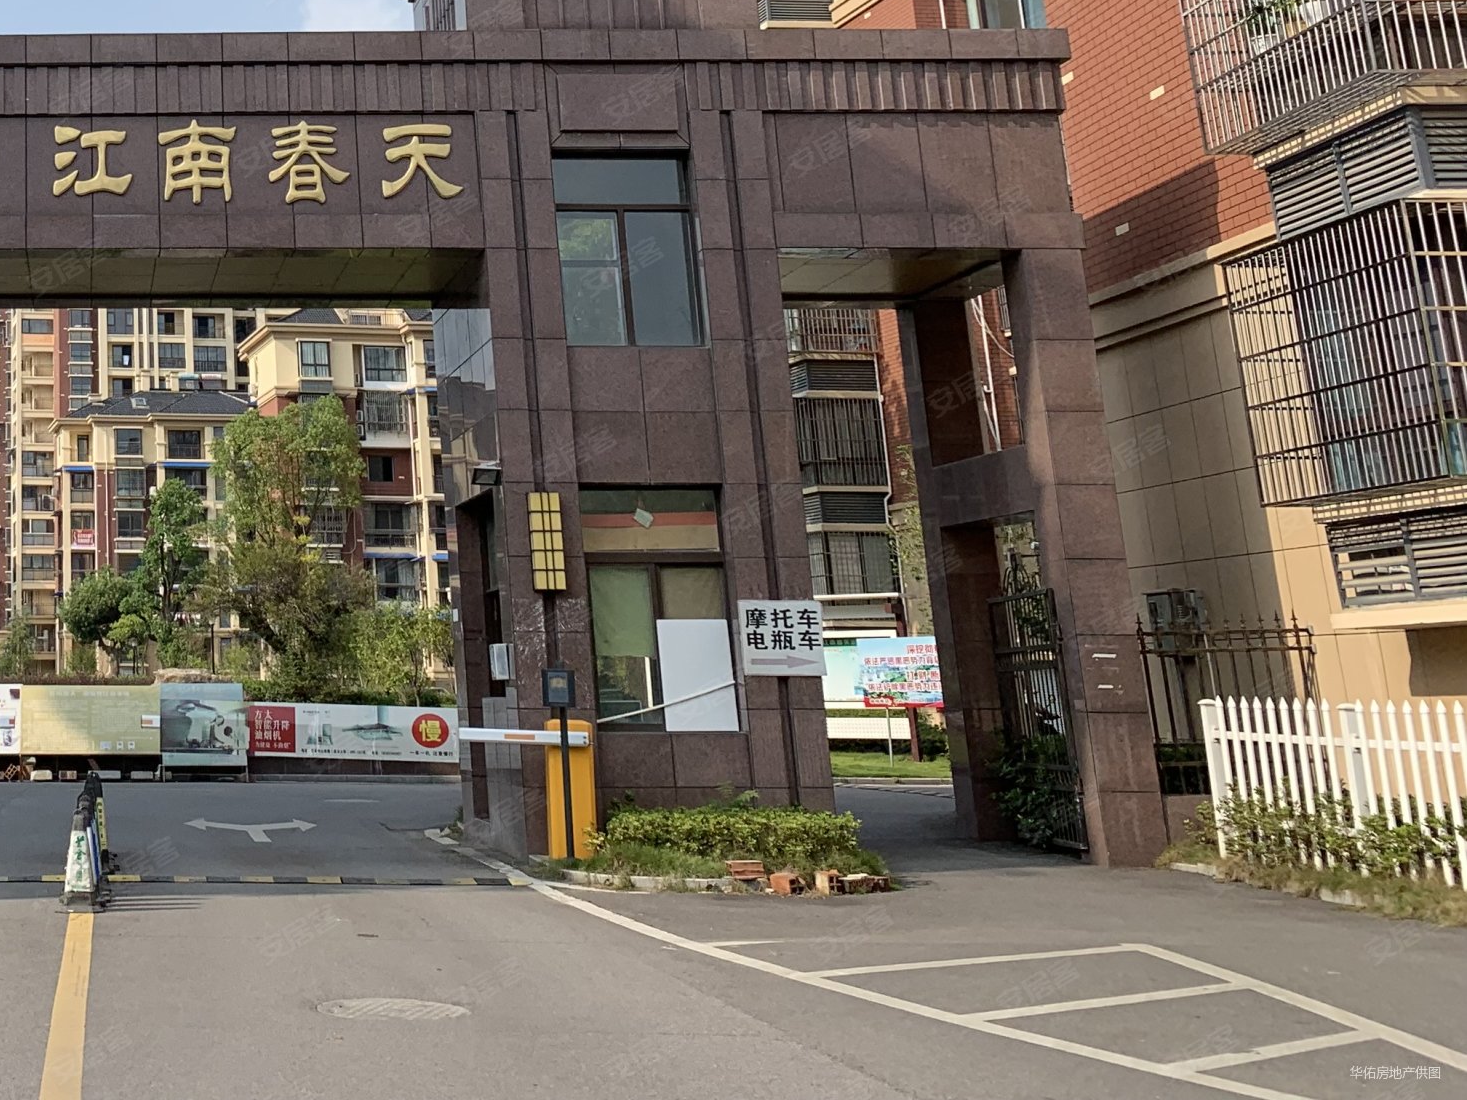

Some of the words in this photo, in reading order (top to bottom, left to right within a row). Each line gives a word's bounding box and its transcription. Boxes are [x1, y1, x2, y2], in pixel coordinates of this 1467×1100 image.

[745, 607, 819, 629] 摩托车
[746, 630, 821, 650] 电瓶车
[254, 709, 273, 720] 方太
[254, 720, 290, 730] 智能升降
[418, 719, 442, 742] 慢
[254, 730, 282, 740] 油烟机
